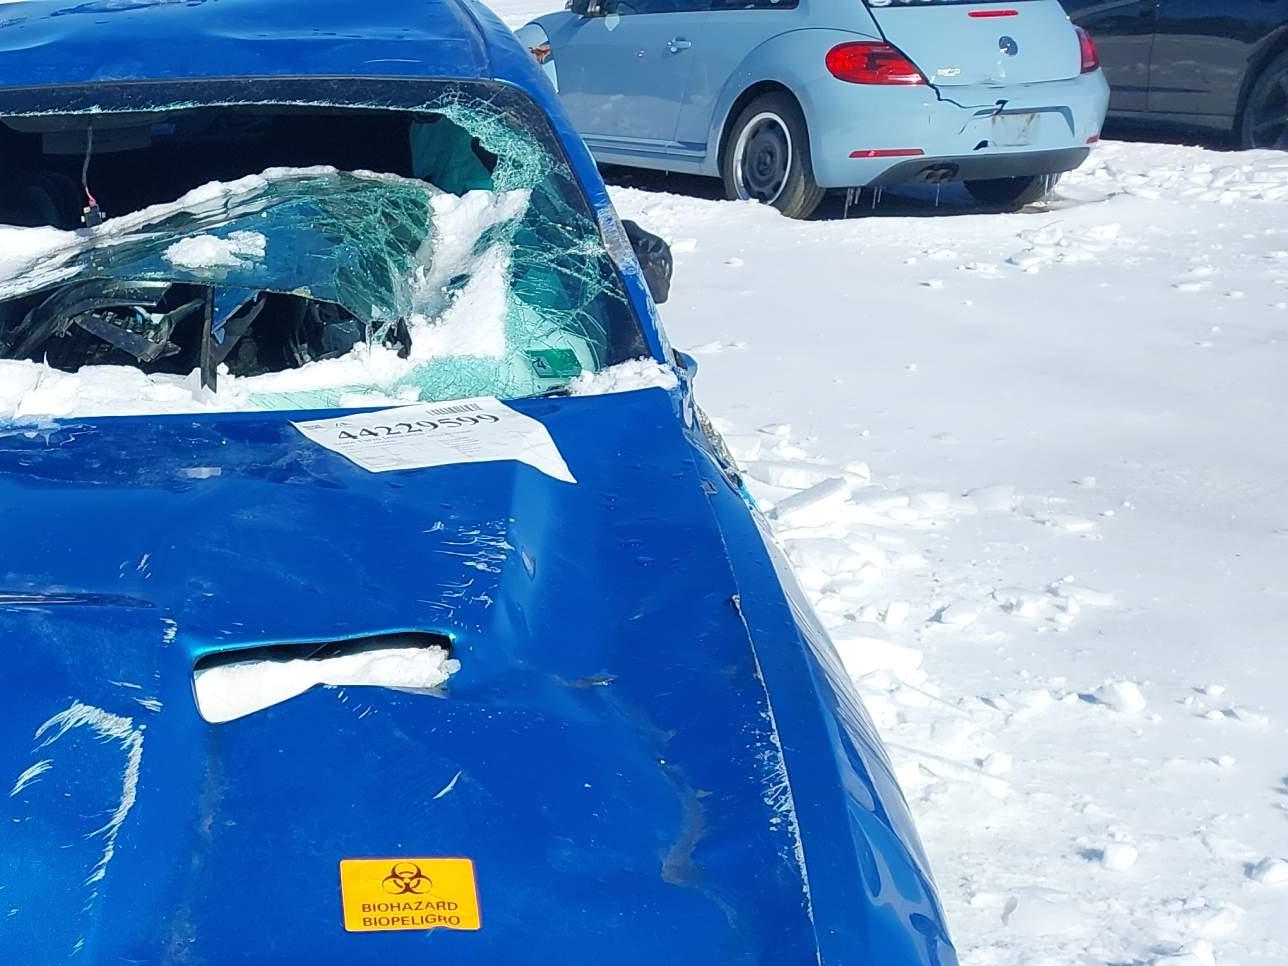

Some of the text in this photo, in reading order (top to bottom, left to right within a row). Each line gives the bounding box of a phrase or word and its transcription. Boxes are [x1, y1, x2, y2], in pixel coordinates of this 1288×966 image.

[337, 413, 500, 441] 44229599
[362, 901, 458, 913] BIOHAZARD
[362, 914, 461, 927] BIOPELIGRO
